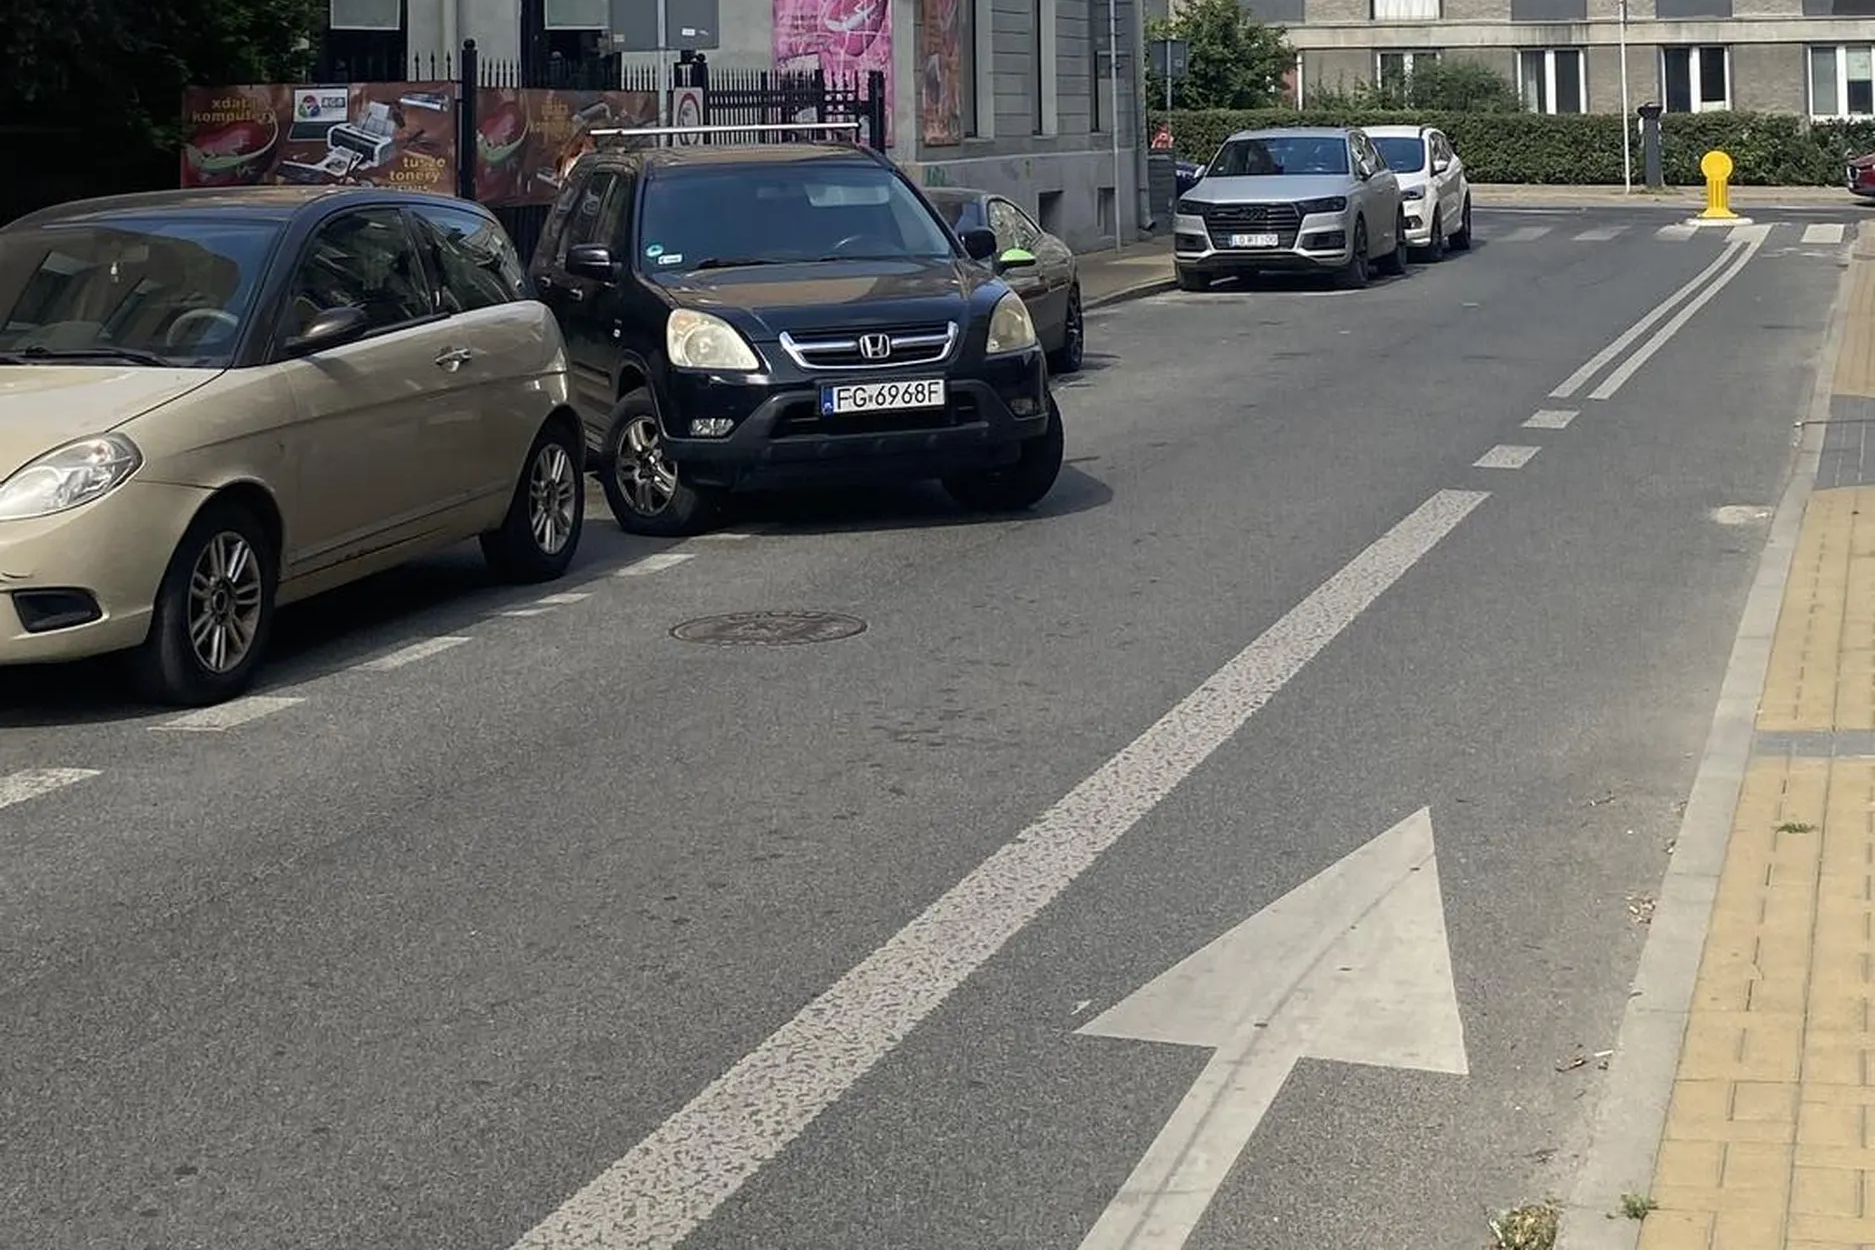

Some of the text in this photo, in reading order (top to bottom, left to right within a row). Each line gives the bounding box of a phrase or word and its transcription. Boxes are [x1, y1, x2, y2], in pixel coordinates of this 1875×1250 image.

[389, 171, 440, 183] tonery
[837, 381, 940, 410] FG 6968F
